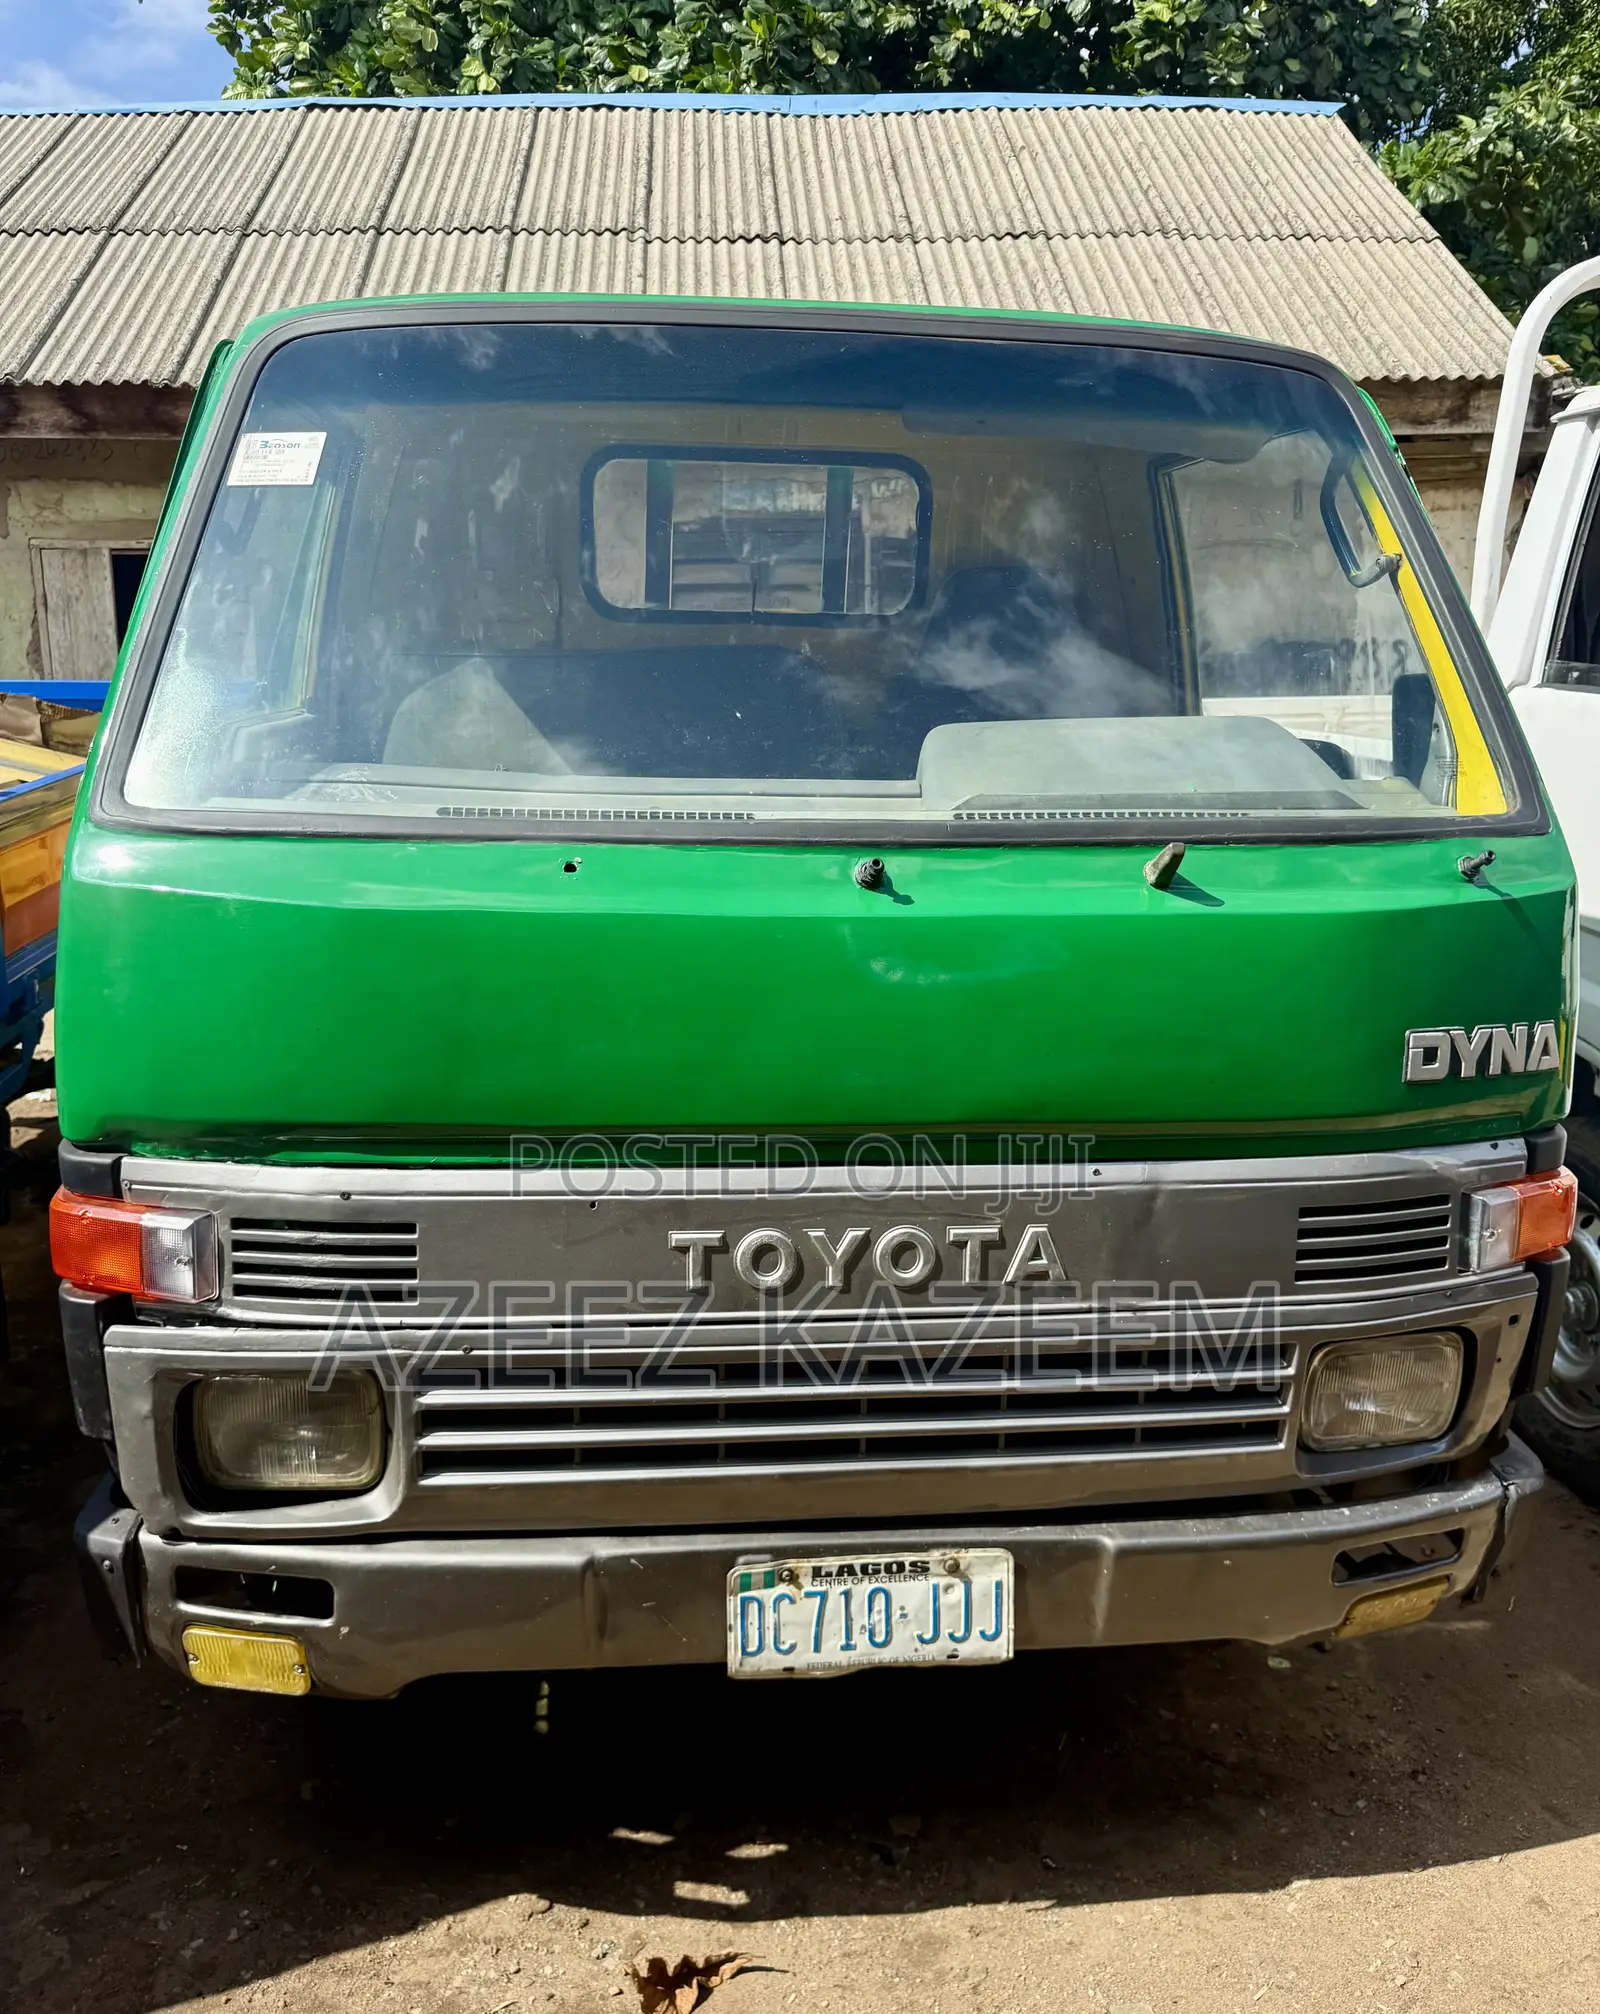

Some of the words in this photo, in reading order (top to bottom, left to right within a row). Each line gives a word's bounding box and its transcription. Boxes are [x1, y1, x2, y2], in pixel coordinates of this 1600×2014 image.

[1402, 1020, 1560, 1084] DYNA
[668, 1223, 1070, 1294] TOYOTA
[811, 1560, 931, 1578] LAGOS
[811, 1577, 849, 1588] CENTRE
[851, 1576, 865, 1586] OF
[868, 1573, 930, 1585] EXCELLENCE
